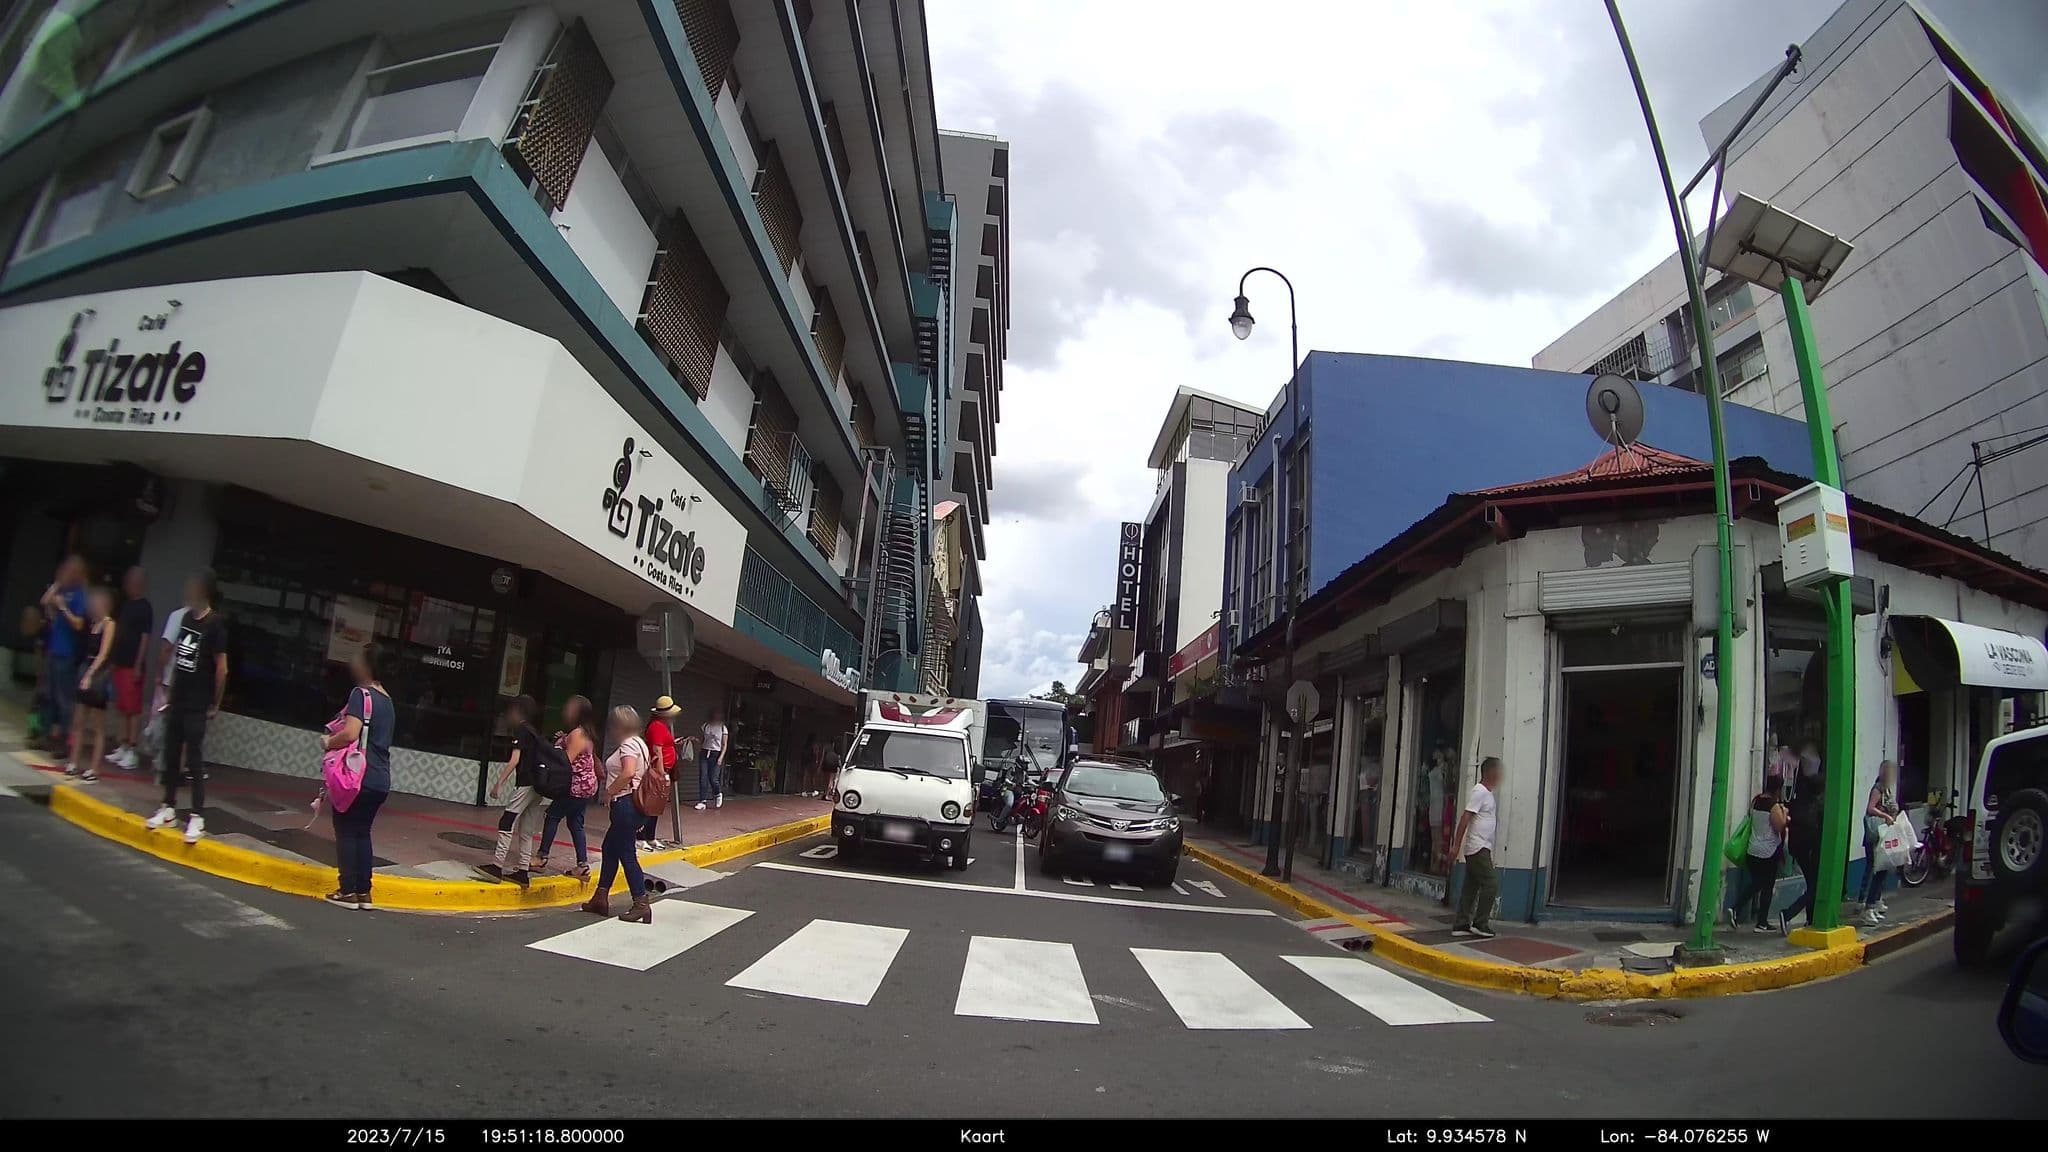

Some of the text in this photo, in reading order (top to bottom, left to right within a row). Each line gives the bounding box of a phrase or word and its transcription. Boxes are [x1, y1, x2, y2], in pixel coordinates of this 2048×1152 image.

[138, 313, 169, 331] Café
[79, 338, 206, 404] Tizate
[93, 407, 156, 424] Costa Rica
[670, 488, 687, 512] Café
[635, 494, 706, 585] Tizate
[647, 562, 683, 595] Costa Rica
[1119, 546, 1136, 629] HOTEL
